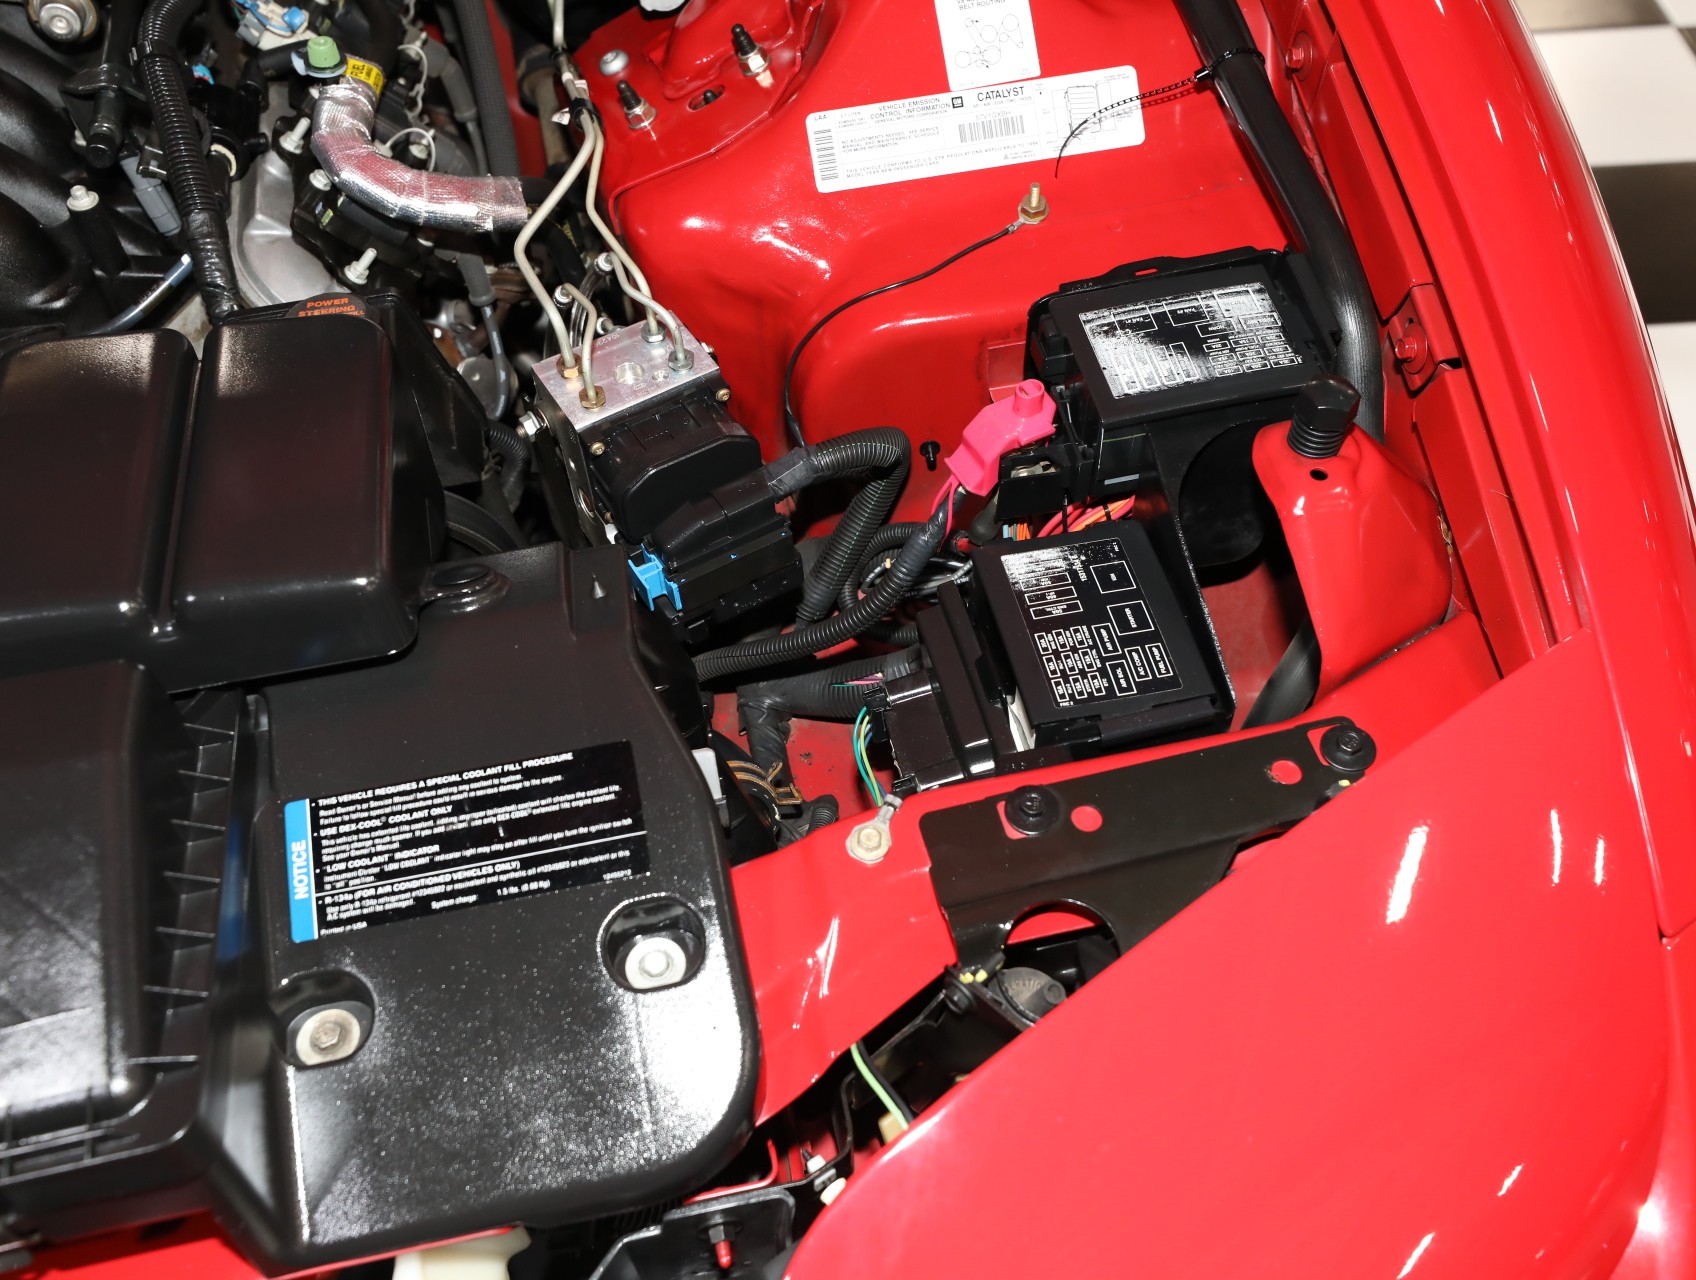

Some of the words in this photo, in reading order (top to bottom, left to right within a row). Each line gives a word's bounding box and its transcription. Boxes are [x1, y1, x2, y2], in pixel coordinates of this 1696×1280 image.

[976, 85, 1025, 101] CATALYST
[869, 109, 902, 120] CONTROL
[904, 101, 951, 114] INFORMATION
[878, 101, 906, 111] VEHICLE
[907, 96, 940, 107] EMISSION
[306, 297, 349, 309] POWER
[298, 305, 356, 318] STEERING
[1123, 607, 1138, 628] STARTER
[1099, 627, 1110, 642] PUMP
[1104, 641, 1114, 651] AIR
[1150, 646, 1162, 660] PUMP
[1130, 650, 1142, 666] COMP
[1114, 667, 1124, 678] SOL
[1156, 660, 1168, 673] FUEL
[1118, 677, 1128, 688] AIR
[317, 796, 337, 806] THIS
[337, 789, 373, 803] VEHICLE
[374, 781, 417, 796] REQUIRES
[418, 779, 425, 788] A
[425, 773, 461, 786] SPECIAL
[462, 765, 502, 779] COOLANT
[503, 761, 521, 772] FILL
[522, 752, 573, 768] PROCEDURE
[319, 826, 337, 836] USE
[387, 809, 429, 824] COOLANT
[429, 804, 453, 816] ONLY
[393, 843, 440, 860] INDICATOR
[291, 839, 310, 900] NOTICE
[353, 887, 376, 900] (FOR
[376, 883, 392, 895] AIR
[392, 872, 452, 892] CONDITIONED
[451, 864, 494, 881] VEHICLES
[493, 858, 520, 873] ONLY)
[320, 925, 344, 937] Printed
[344, 923, 352, 932] in
[351, 920, 367, 930] USA
